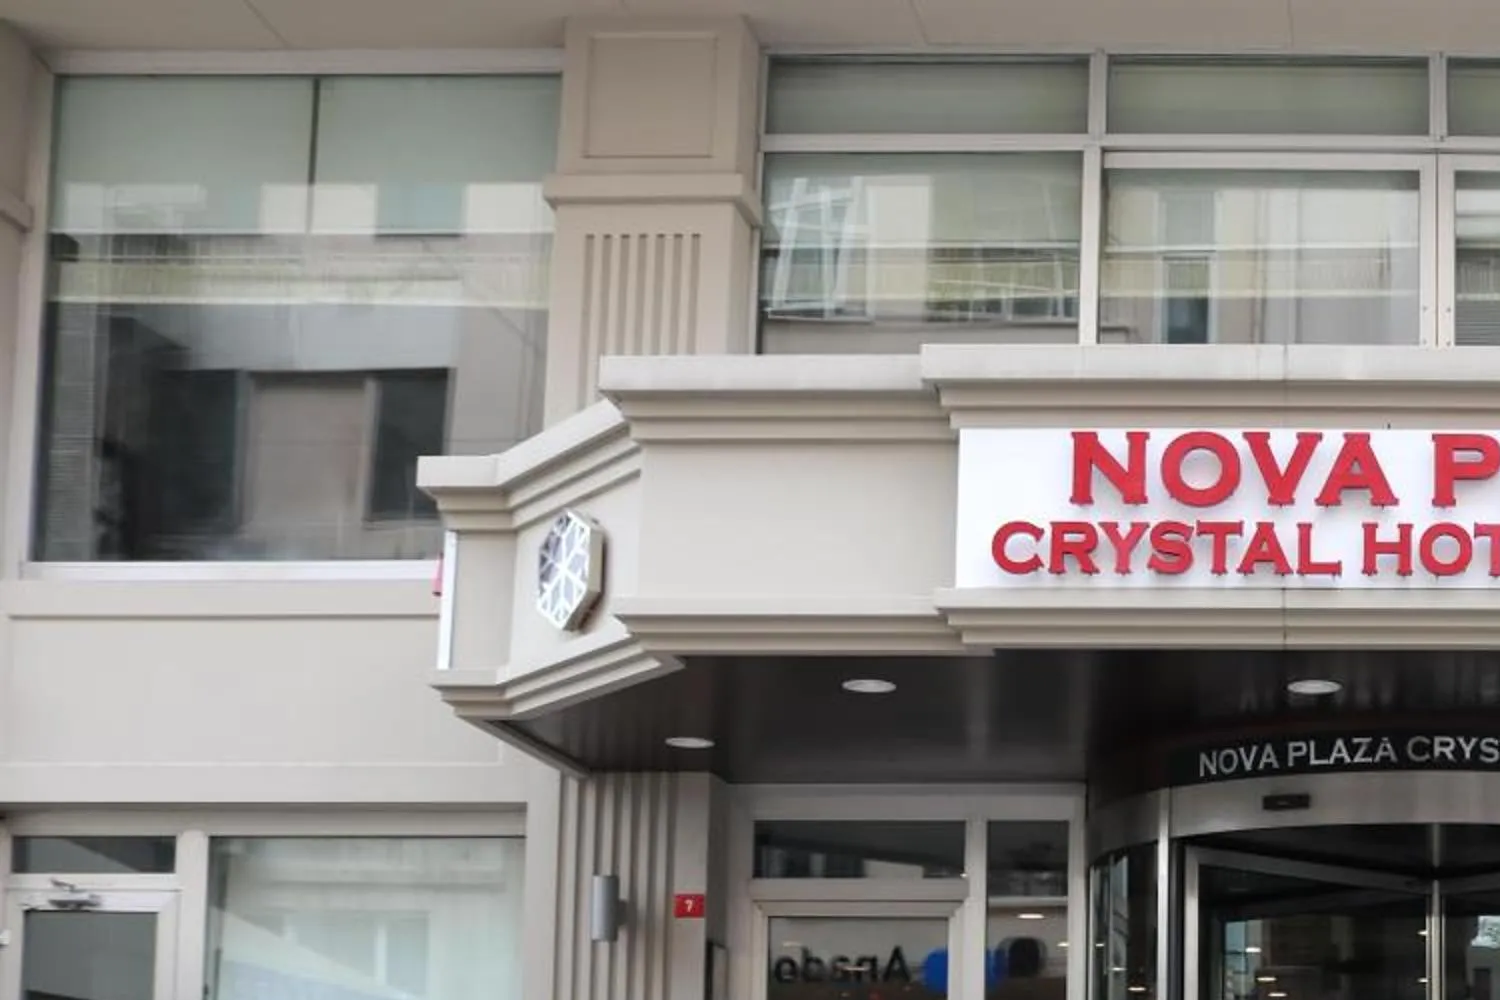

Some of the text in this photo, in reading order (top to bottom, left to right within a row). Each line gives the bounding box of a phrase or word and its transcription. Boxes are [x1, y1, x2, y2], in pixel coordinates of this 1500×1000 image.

[1071, 430, 1398, 507] NOVA
[990, 520, 1342, 576] CRYSTAL
[1199, 743, 1280, 777] NOVA
[1287, 736, 1399, 767] PLAZA
